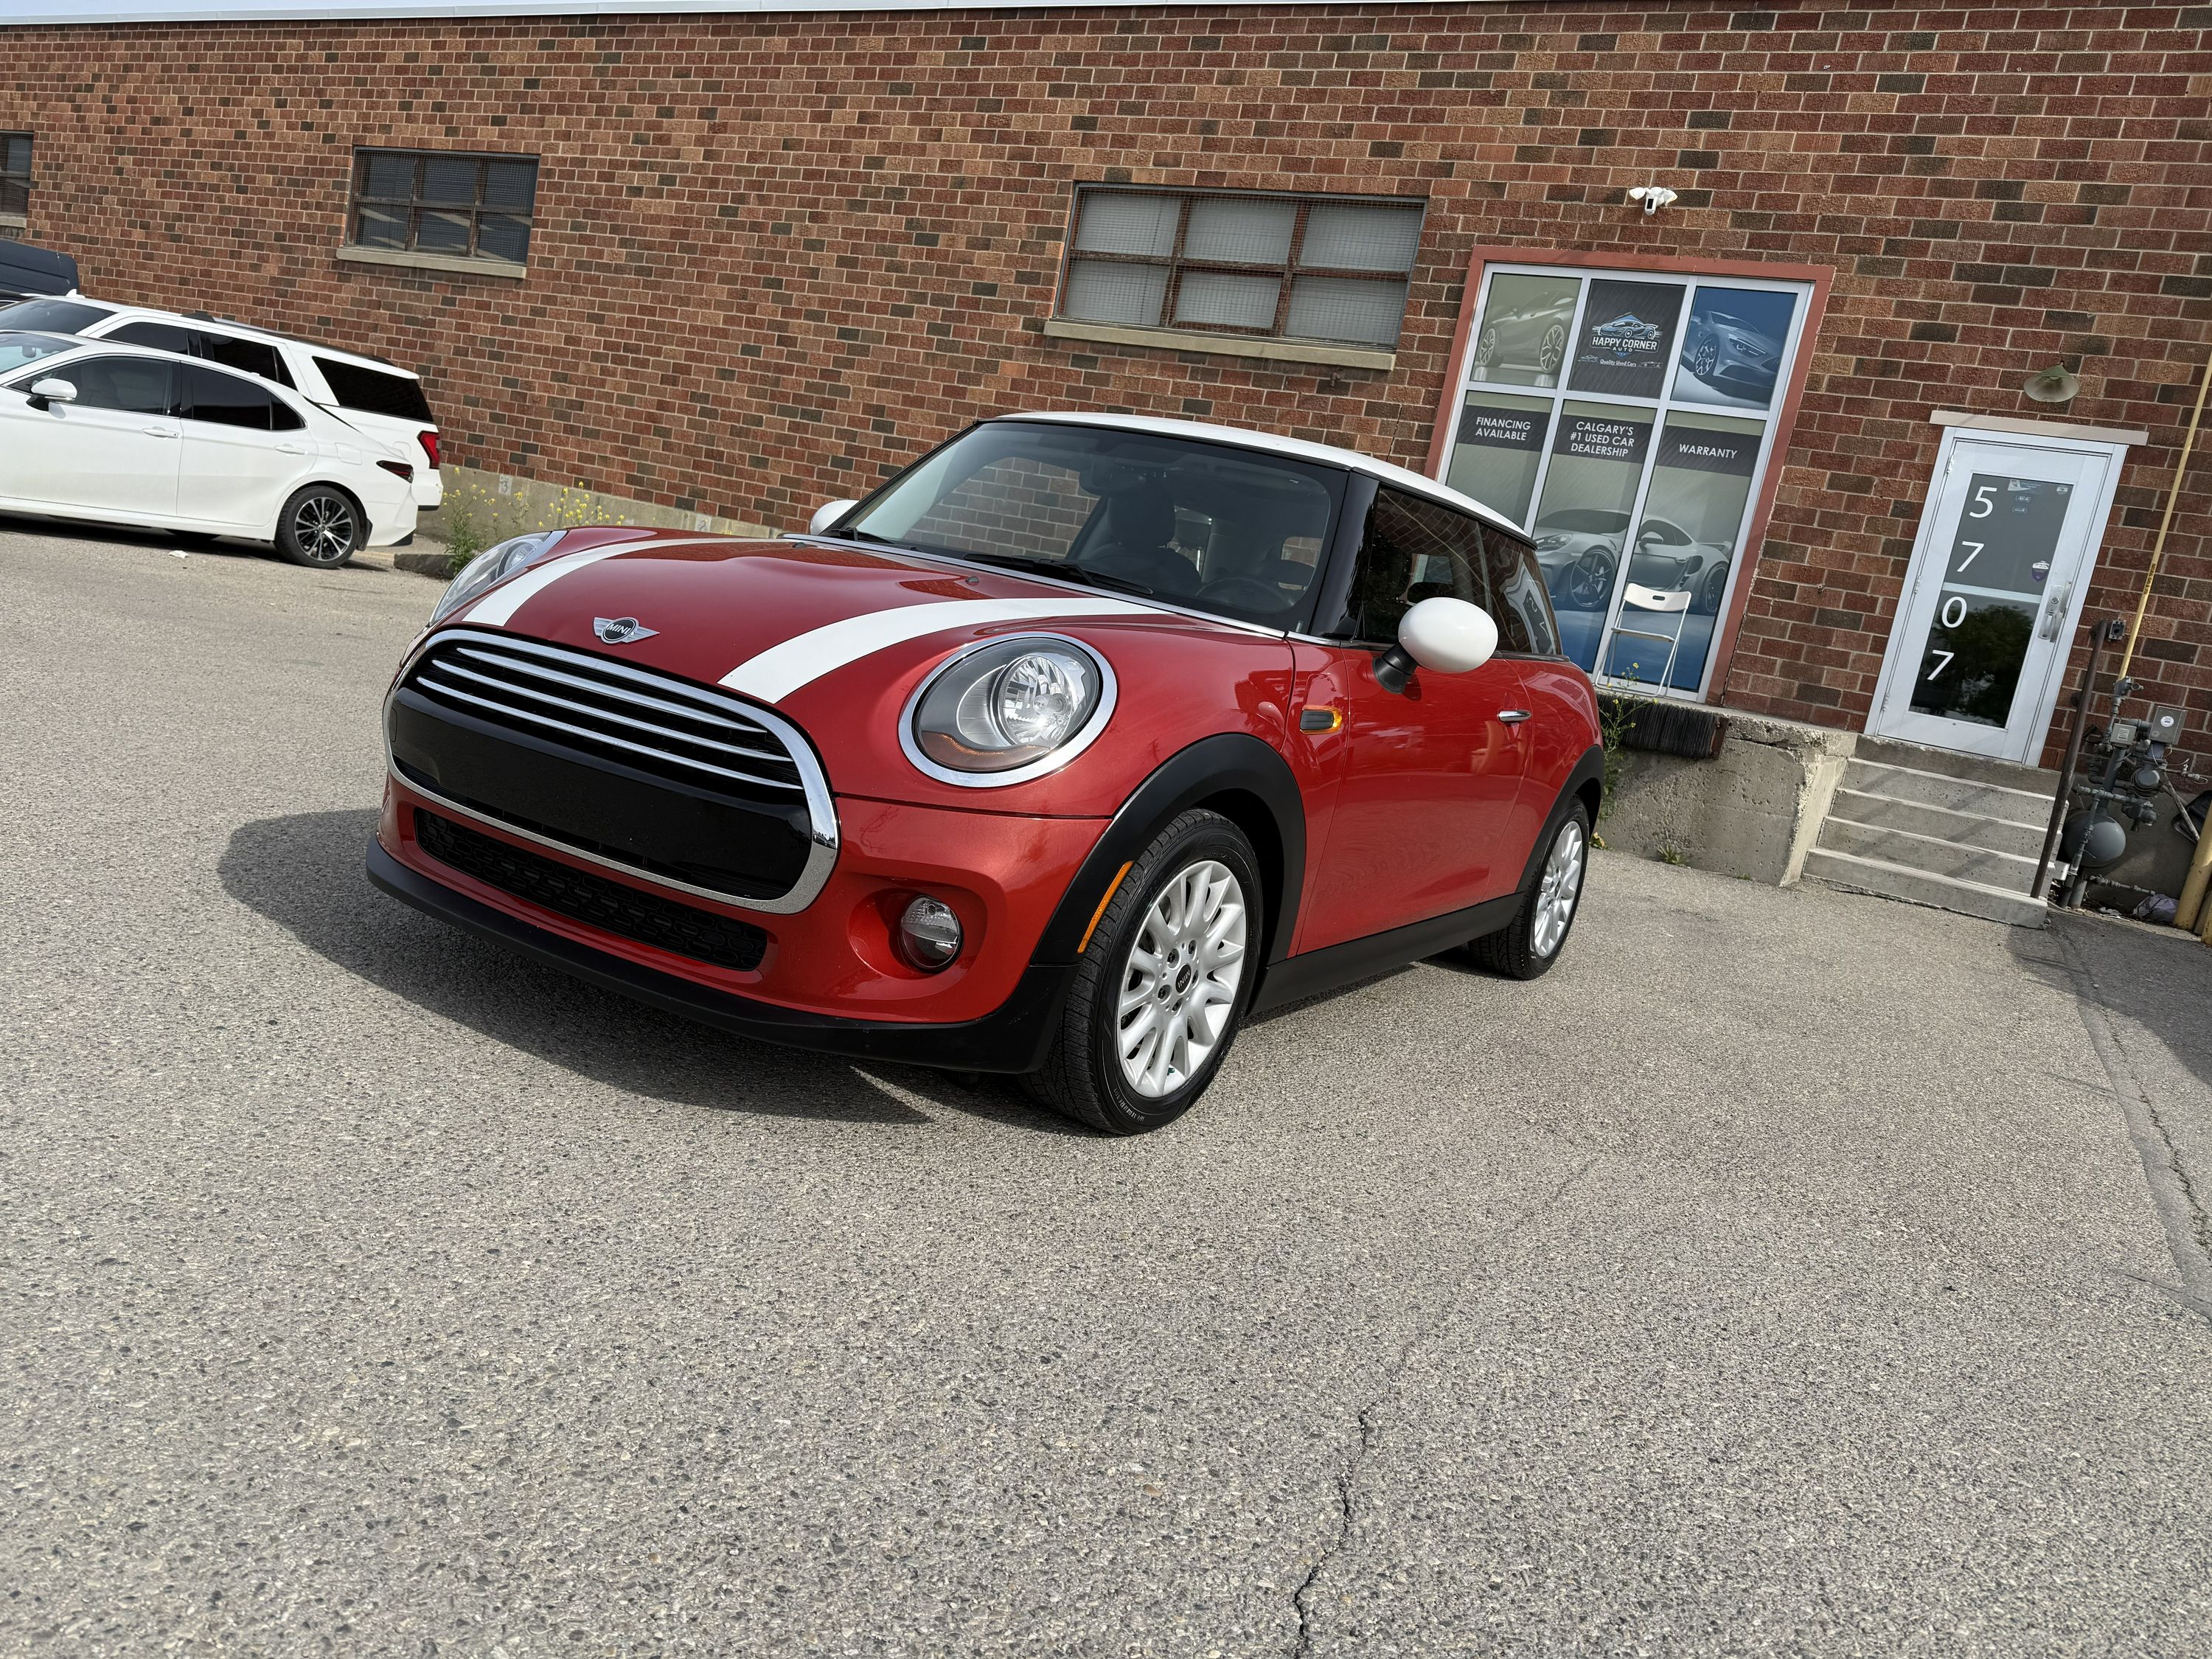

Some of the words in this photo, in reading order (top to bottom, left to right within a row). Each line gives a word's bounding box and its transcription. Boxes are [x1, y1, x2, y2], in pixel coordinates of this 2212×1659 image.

[1592, 336, 1622, 347] HAPPY
[1622, 339, 1658, 350] CORNER
[1475, 417, 1531, 431] FINANCING
[1576, 421, 1634, 436] CALGARY'S
[1475, 429, 1527, 441] AVAILABLE
[1570, 432, 1582, 442] #1
[1585, 433, 1610, 445] USED
[1612, 436, 1635, 447] CAR
[1571, 443, 1629, 457] DEALERSHIP
[1679, 444, 1738, 459] WARRANTY
[608, 623, 631, 635] MINI
[1178, 970, 1190, 988] MINI
